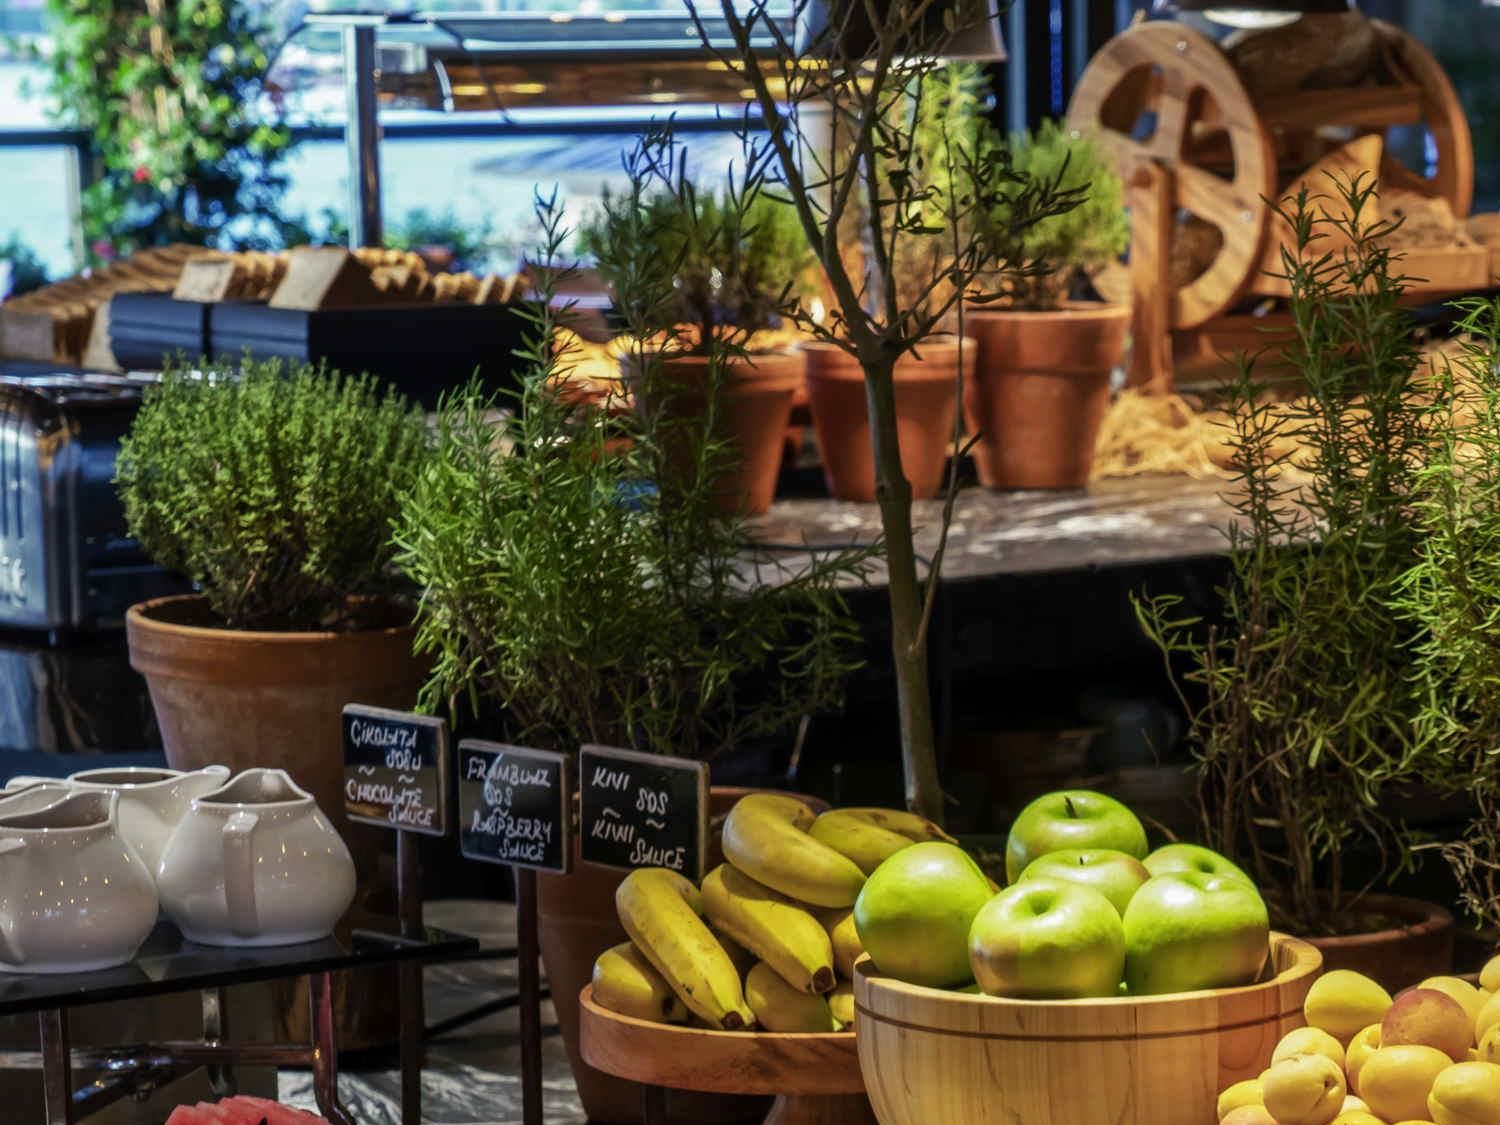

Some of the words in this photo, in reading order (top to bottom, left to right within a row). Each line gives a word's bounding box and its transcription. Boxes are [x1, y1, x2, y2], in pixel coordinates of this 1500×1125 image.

[592, 766, 630, 791] KIVI
[346, 778, 423, 807] CHOCOLATE
[636, 787, 669, 815] SOS
[388, 803, 435, 826] SAUCE
[471, 810, 552, 843] RASPBERRY
[591, 819, 635, 844] KIWI
[499, 839, 545, 861] SAUCE
[630, 838, 685, 870] SAUCE
